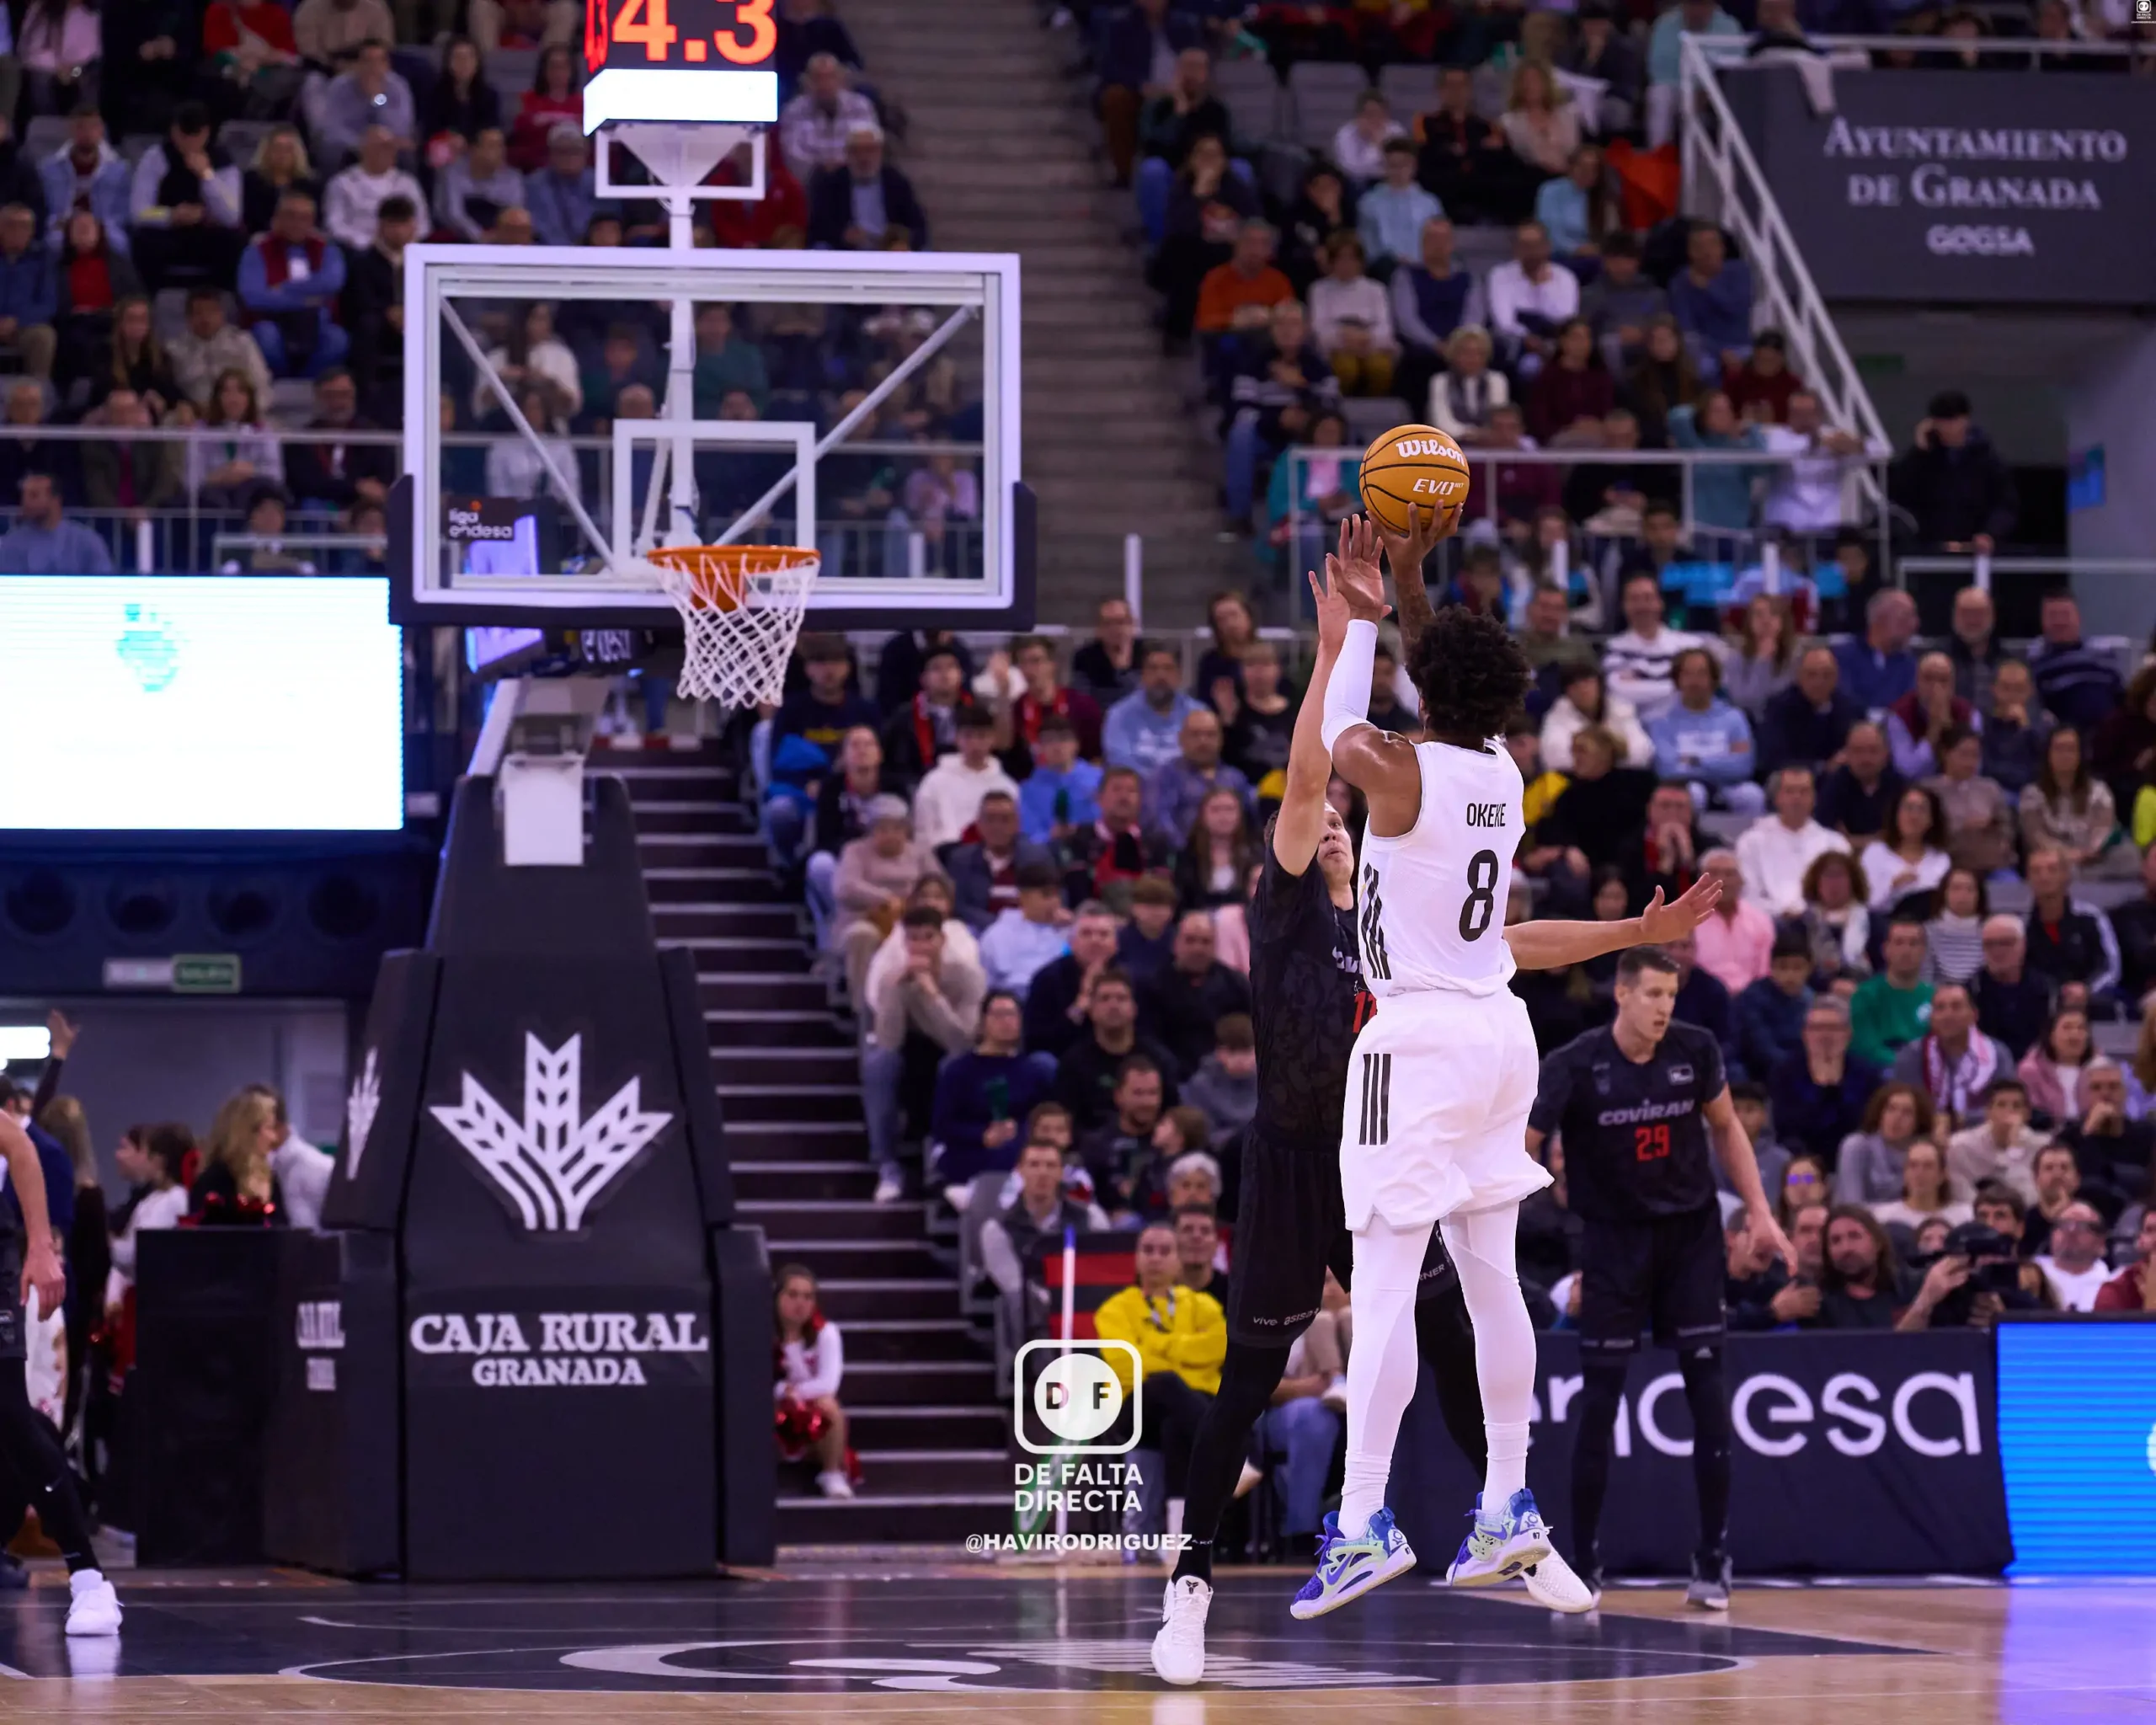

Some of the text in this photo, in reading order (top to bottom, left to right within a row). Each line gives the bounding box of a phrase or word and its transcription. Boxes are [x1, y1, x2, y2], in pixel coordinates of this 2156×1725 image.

[611, 0, 777, 65] 4.3
[1396, 439, 1466, 467] Wilson
[1412, 478, 1455, 496] EVO
[1465, 802, 1507, 828] OKEKE
[1459, 849, 1499, 943] 8
[1634, 1124, 1671, 1162] 29
[409, 1311, 710, 1355] CAJA RURAL
[472, 1357, 647, 1387] GRANADA
